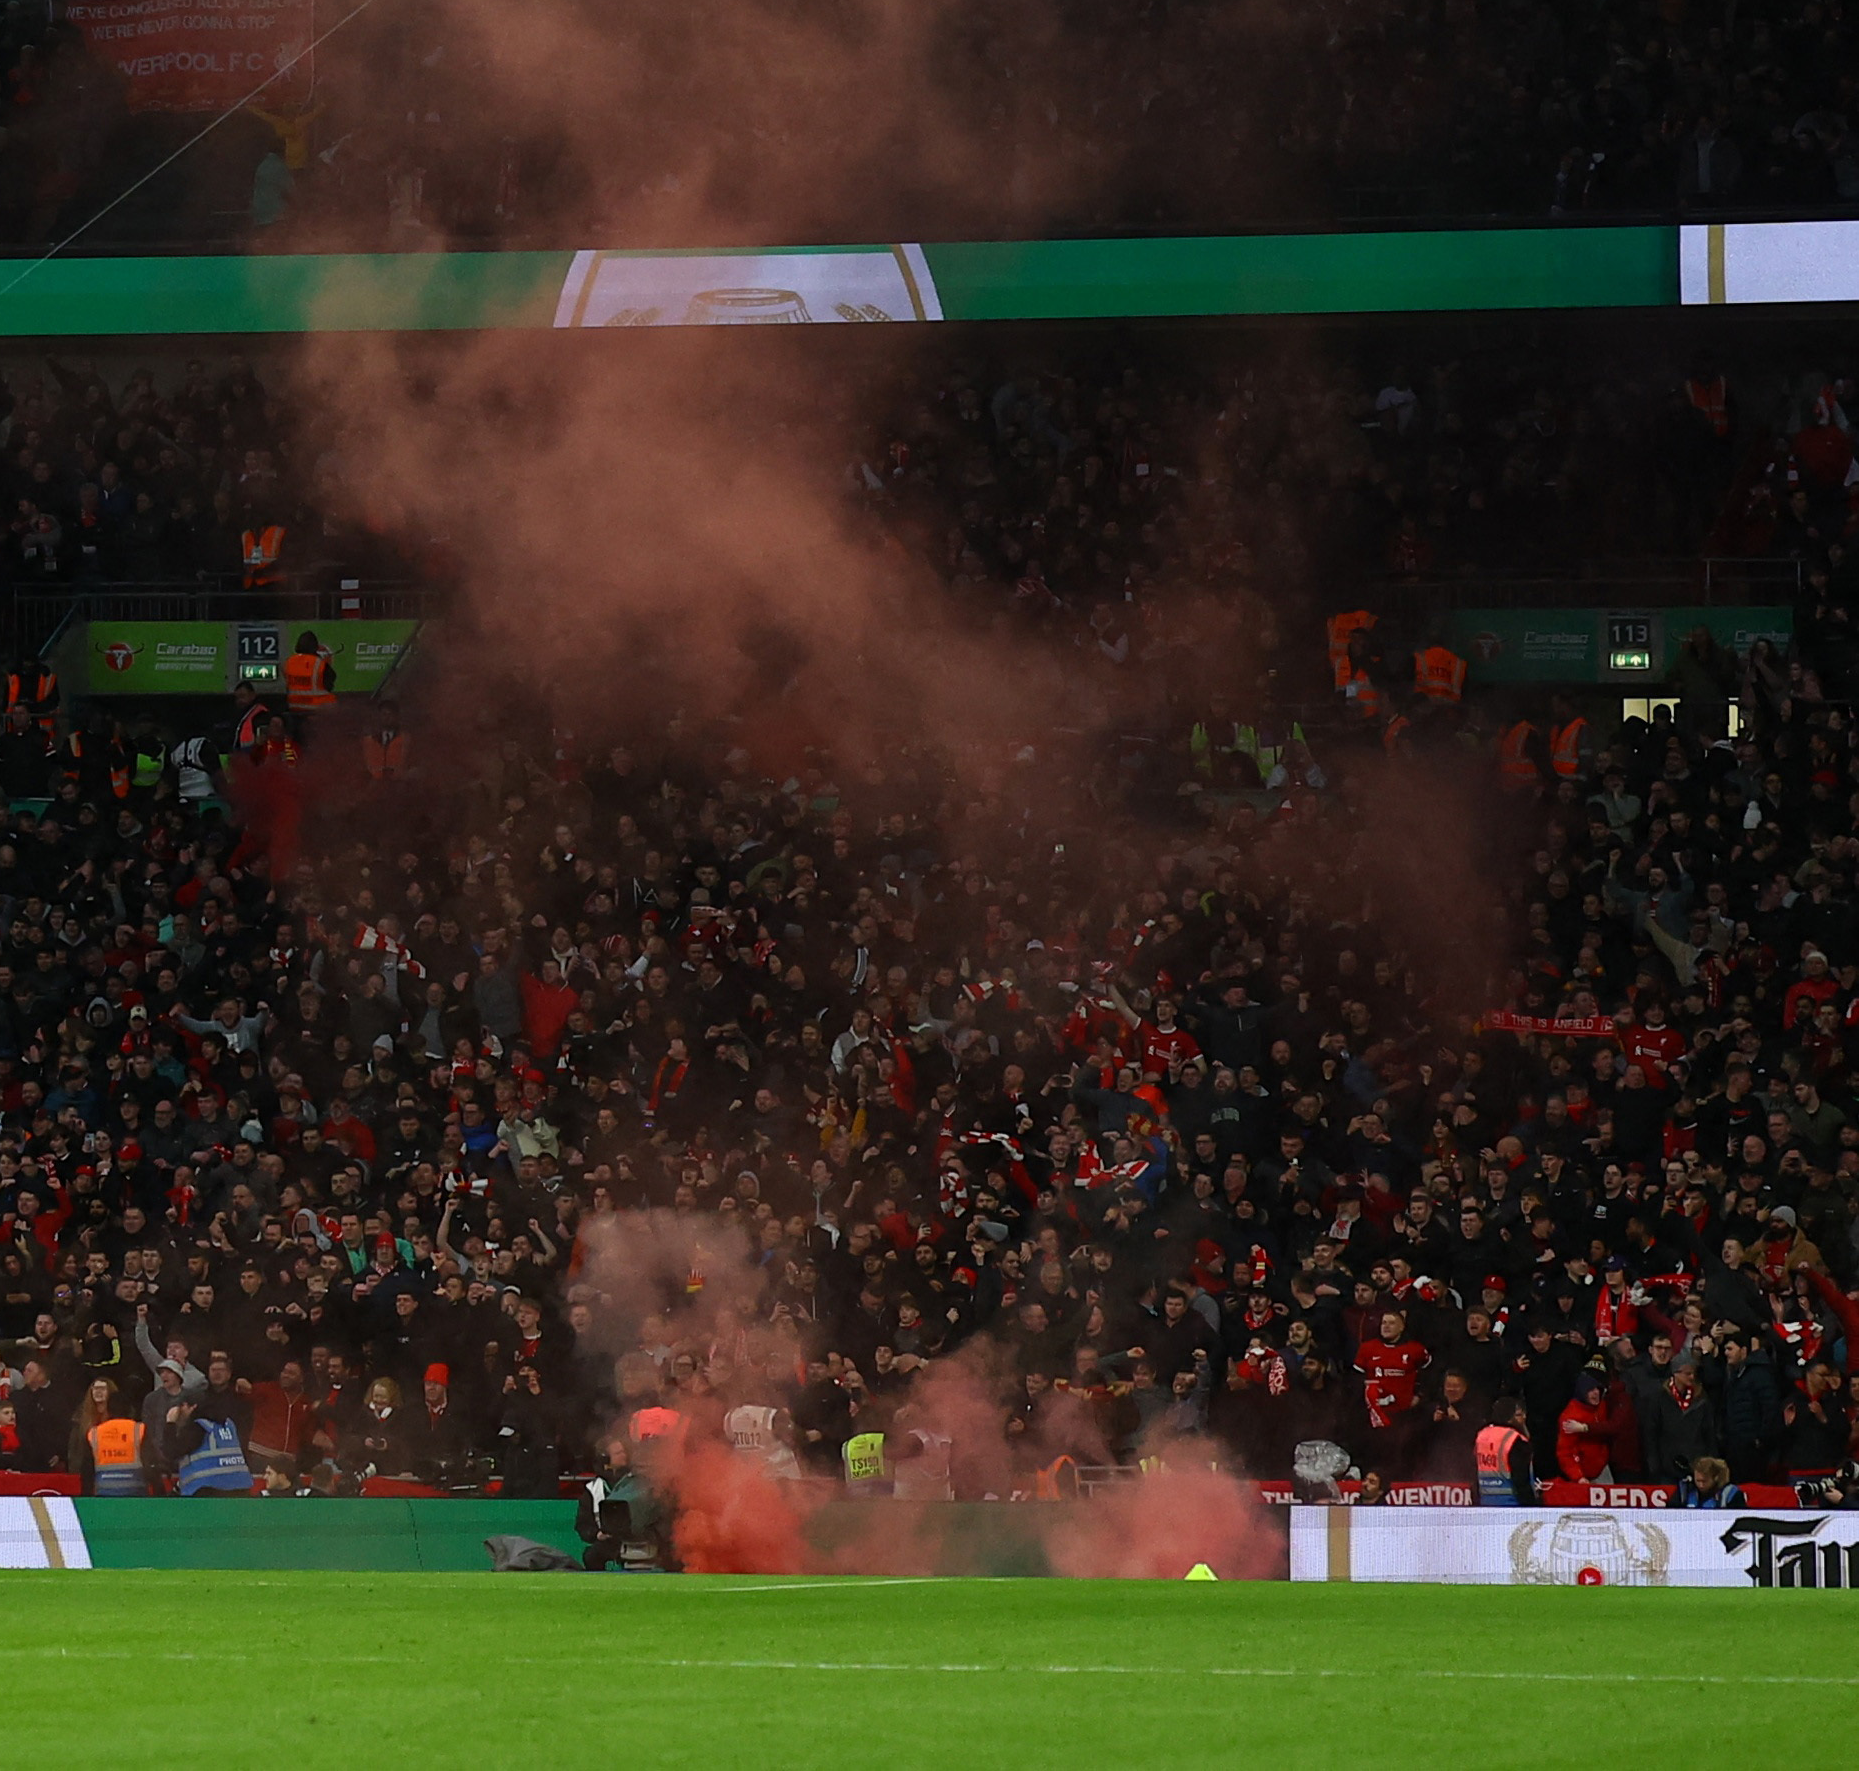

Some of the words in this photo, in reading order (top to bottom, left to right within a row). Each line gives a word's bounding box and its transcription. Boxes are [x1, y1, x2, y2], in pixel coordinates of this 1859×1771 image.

[1524, 631, 1589, 645] Carabao
[1612, 625, 1648, 642] 113
[155, 642, 218, 656] Carabao
[240, 636, 277, 654] 112
[1511, 1014, 1533, 1027] THIS
[1537, 1017, 1548, 1028] IS
[1553, 1017, 1594, 1031] ANFIELD
[1589, 1485, 1668, 1508] REDS
